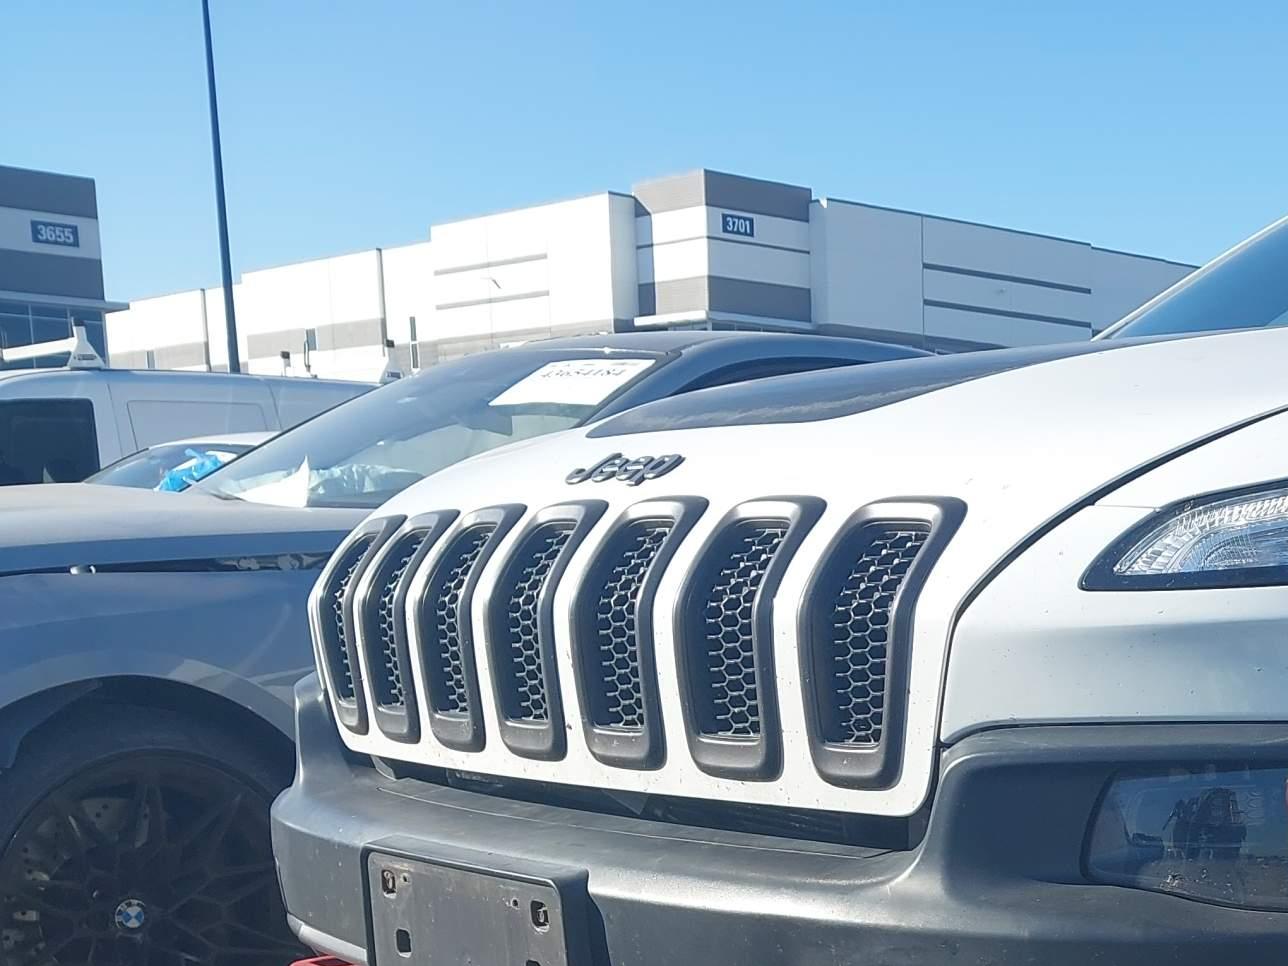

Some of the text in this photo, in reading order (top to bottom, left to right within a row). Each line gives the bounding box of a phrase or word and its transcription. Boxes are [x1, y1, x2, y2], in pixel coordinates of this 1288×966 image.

[37, 224, 74, 244] 3655
[725, 217, 752, 234] 3701
[562, 451, 688, 488] Jeep
